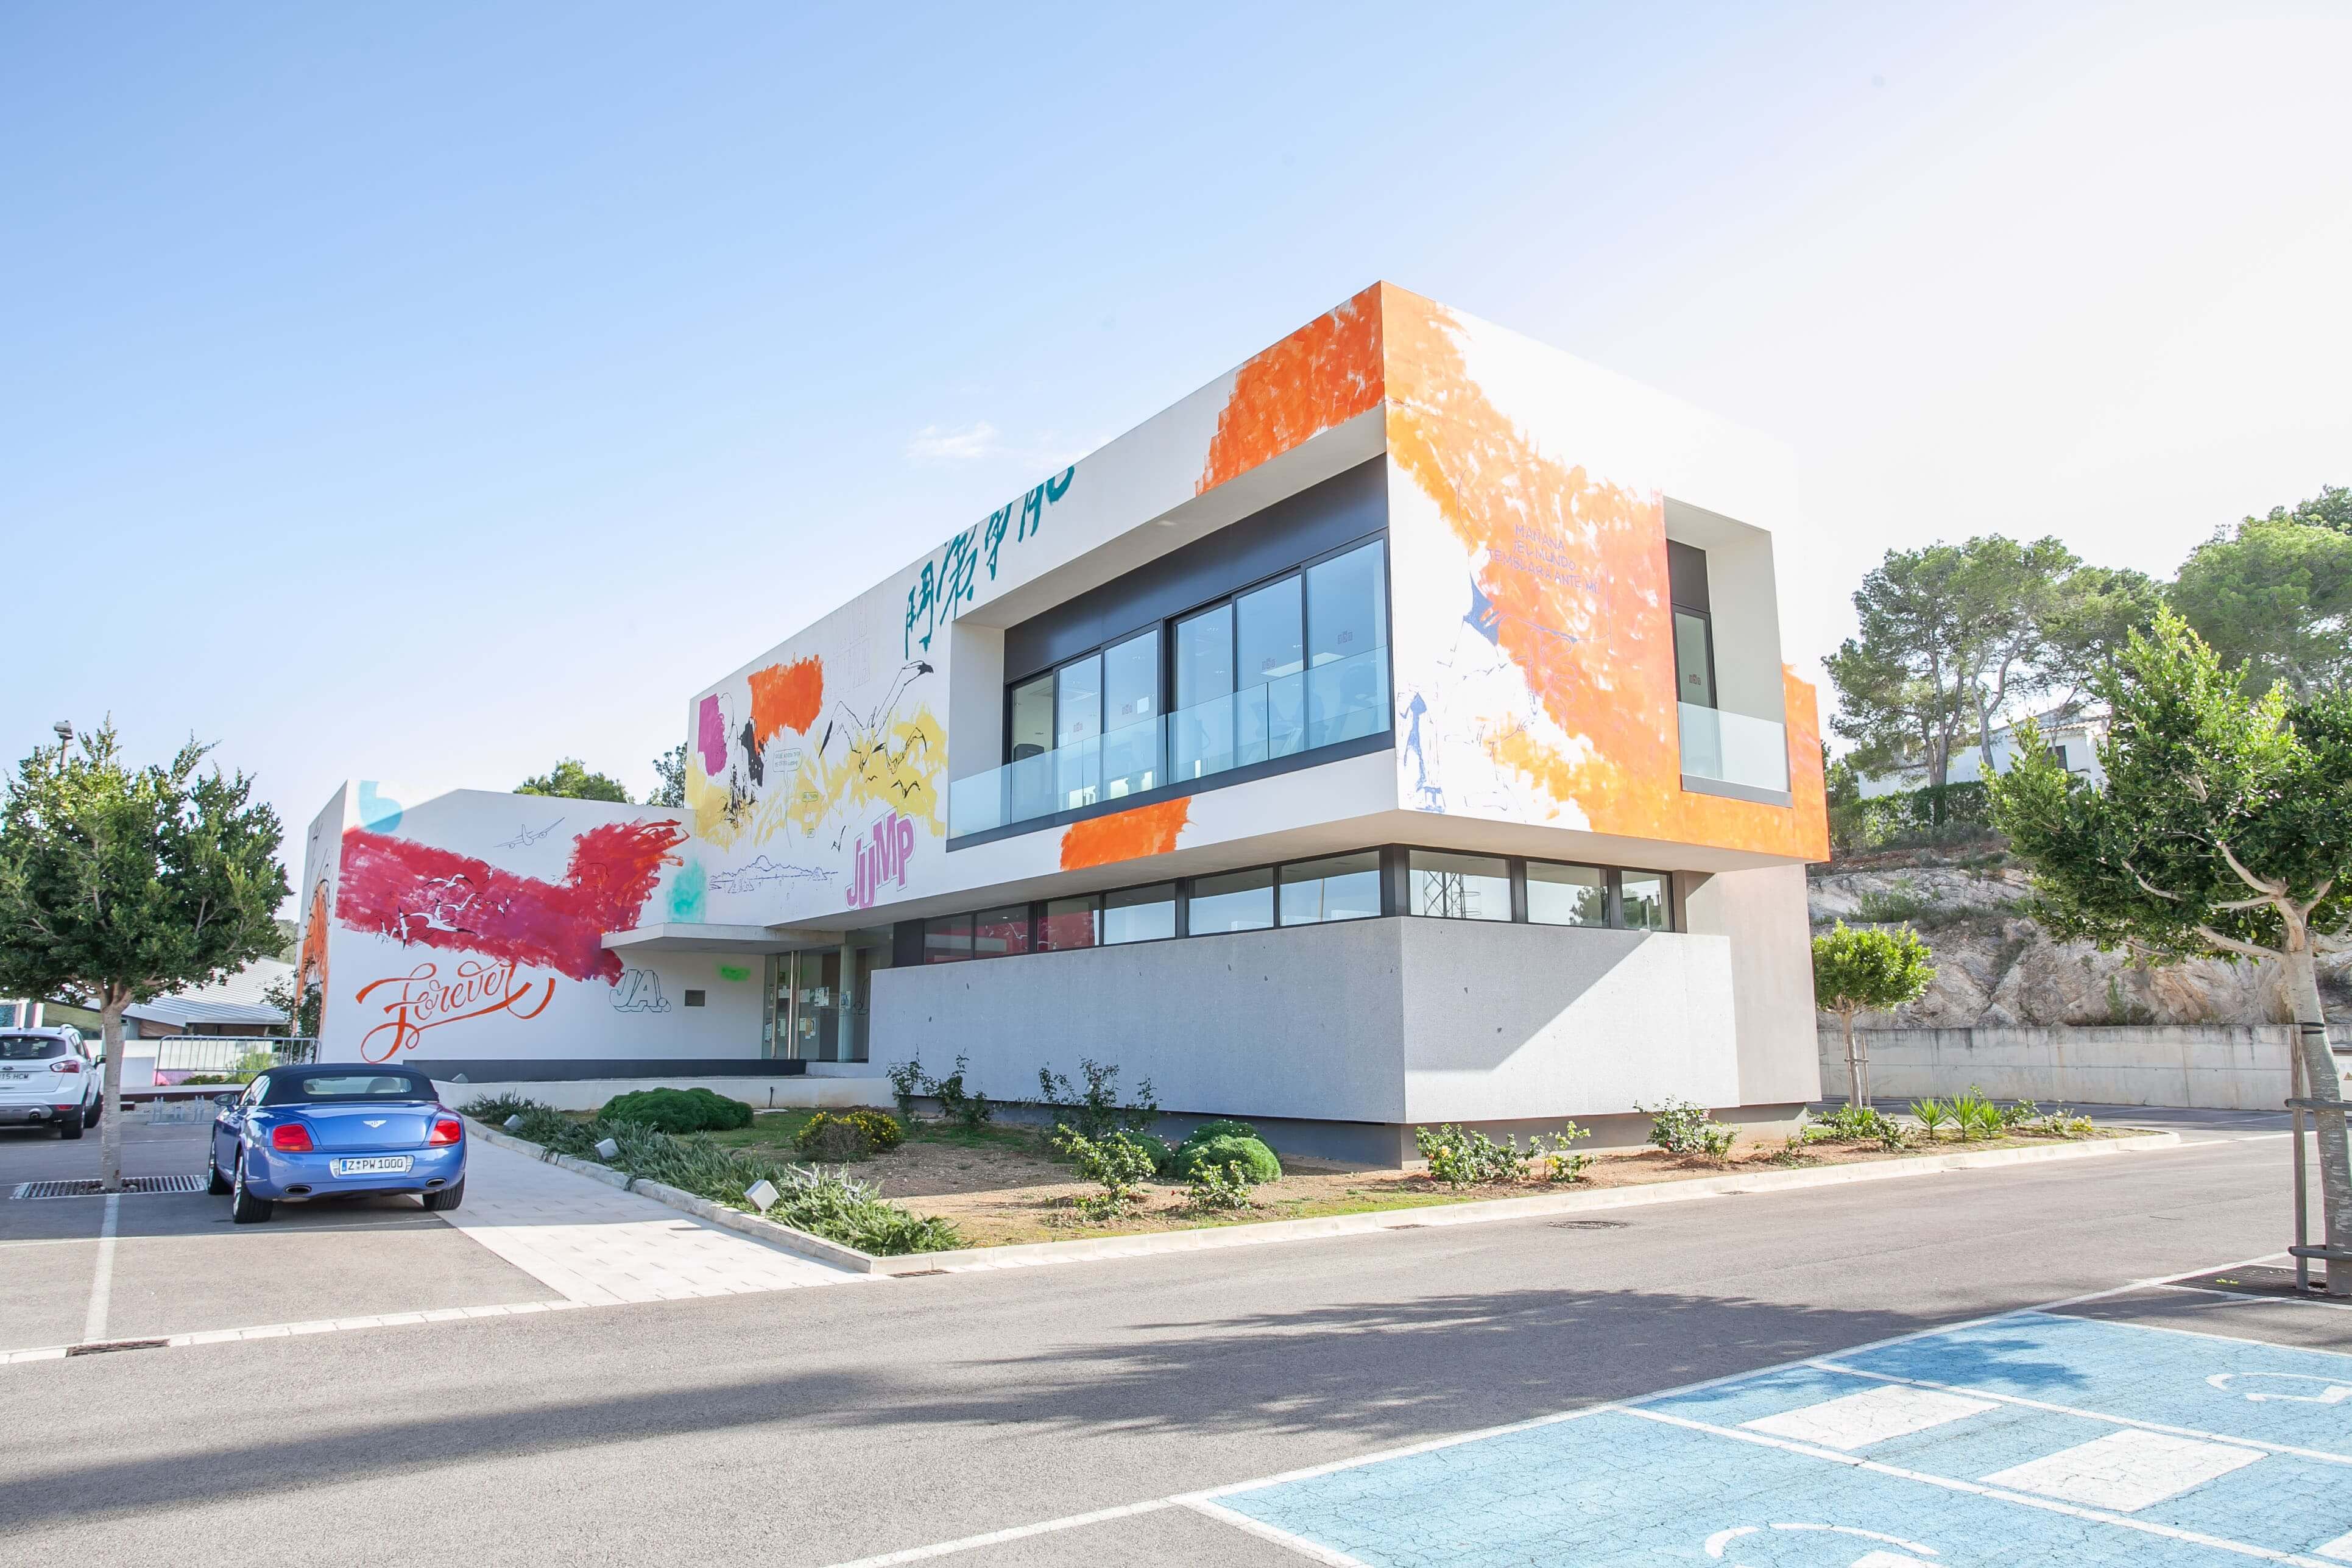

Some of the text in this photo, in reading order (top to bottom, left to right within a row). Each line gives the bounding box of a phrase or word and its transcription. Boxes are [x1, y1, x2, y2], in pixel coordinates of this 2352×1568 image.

[1535, 546, 1577, 570] MUNDO
[1555, 571, 1581, 588] ANTE
[846, 807, 915, 909] JUMP
[356, 961, 556, 1063] Forever
[348, 1161, 355, 1170] Z
[378, 1159, 403, 1168] 1000
